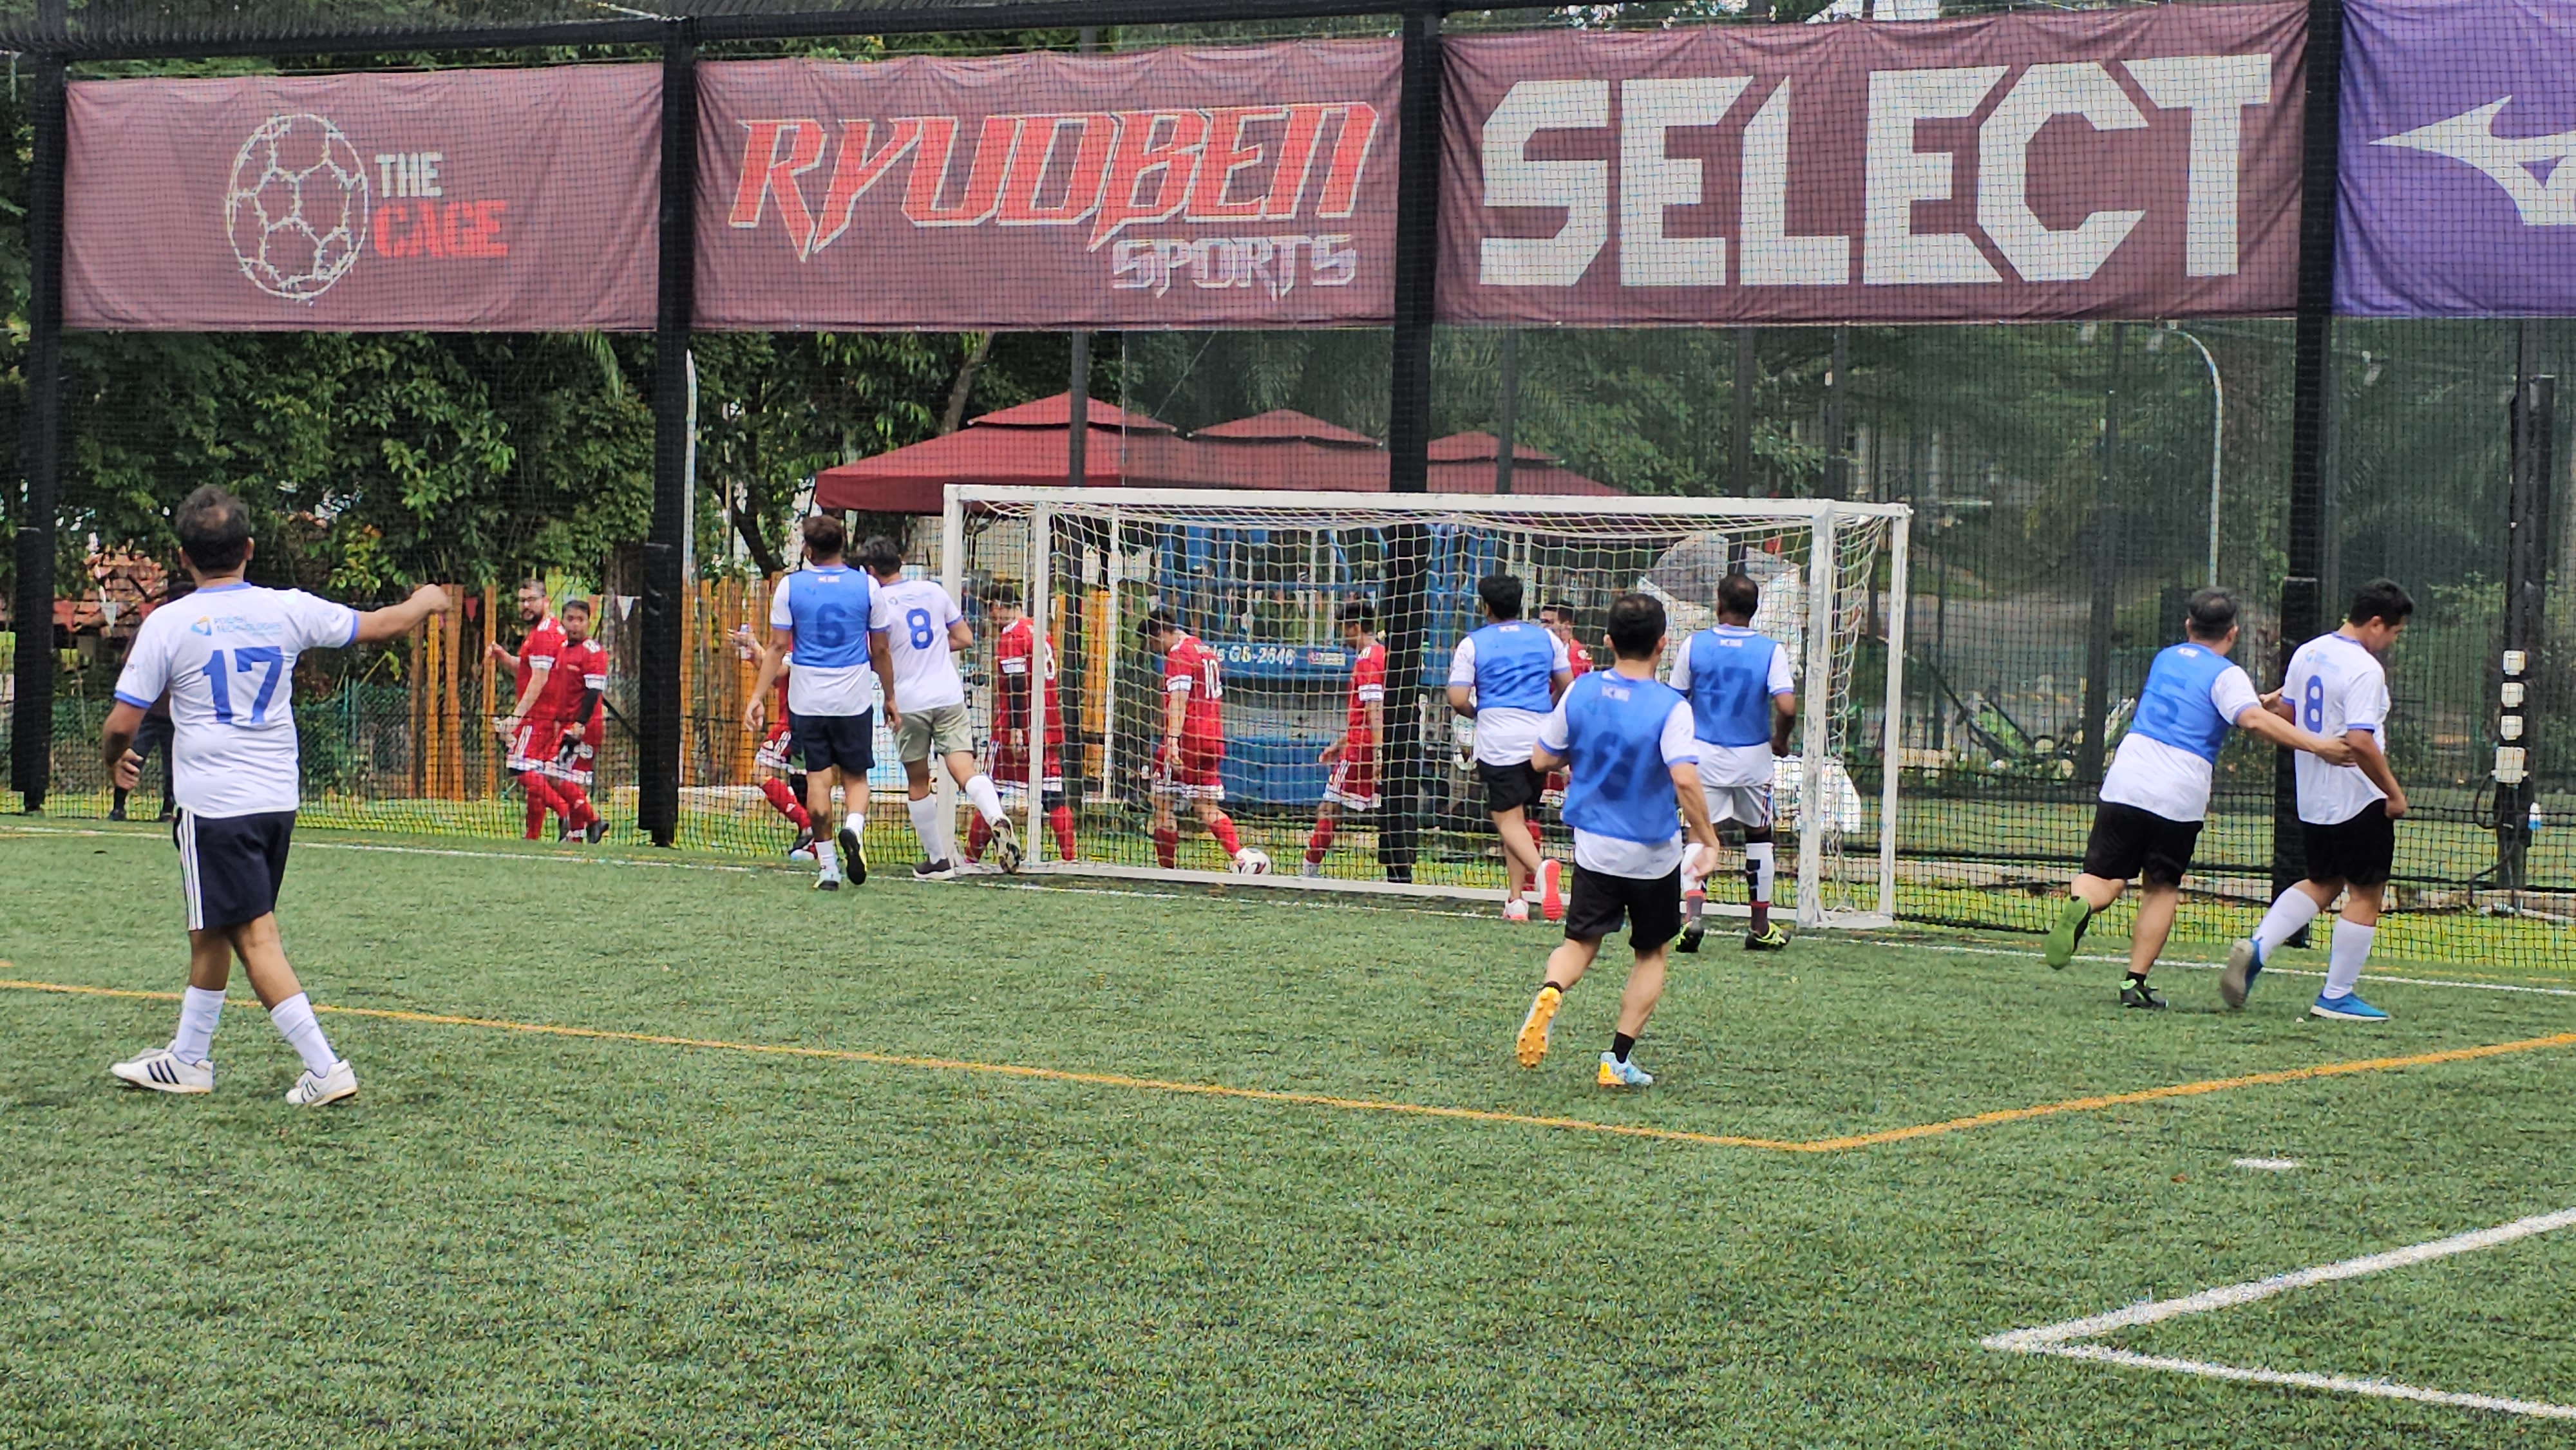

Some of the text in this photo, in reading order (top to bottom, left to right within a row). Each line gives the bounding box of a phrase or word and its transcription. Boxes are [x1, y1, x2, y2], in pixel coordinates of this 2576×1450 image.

[375, 152, 443, 198] THE
[1479, 53, 2272, 287] SELECT
[374, 201, 507, 257] CAGE
[1112, 234, 1357, 301] SPORTS
[816, 603, 846, 648] 6
[905, 608, 933, 650] 8
[202, 646, 283, 724] 17
[1202, 658, 1223, 699] 10
[2145, 673, 2187, 729] 5
[2303, 675, 2324, 733] 8
